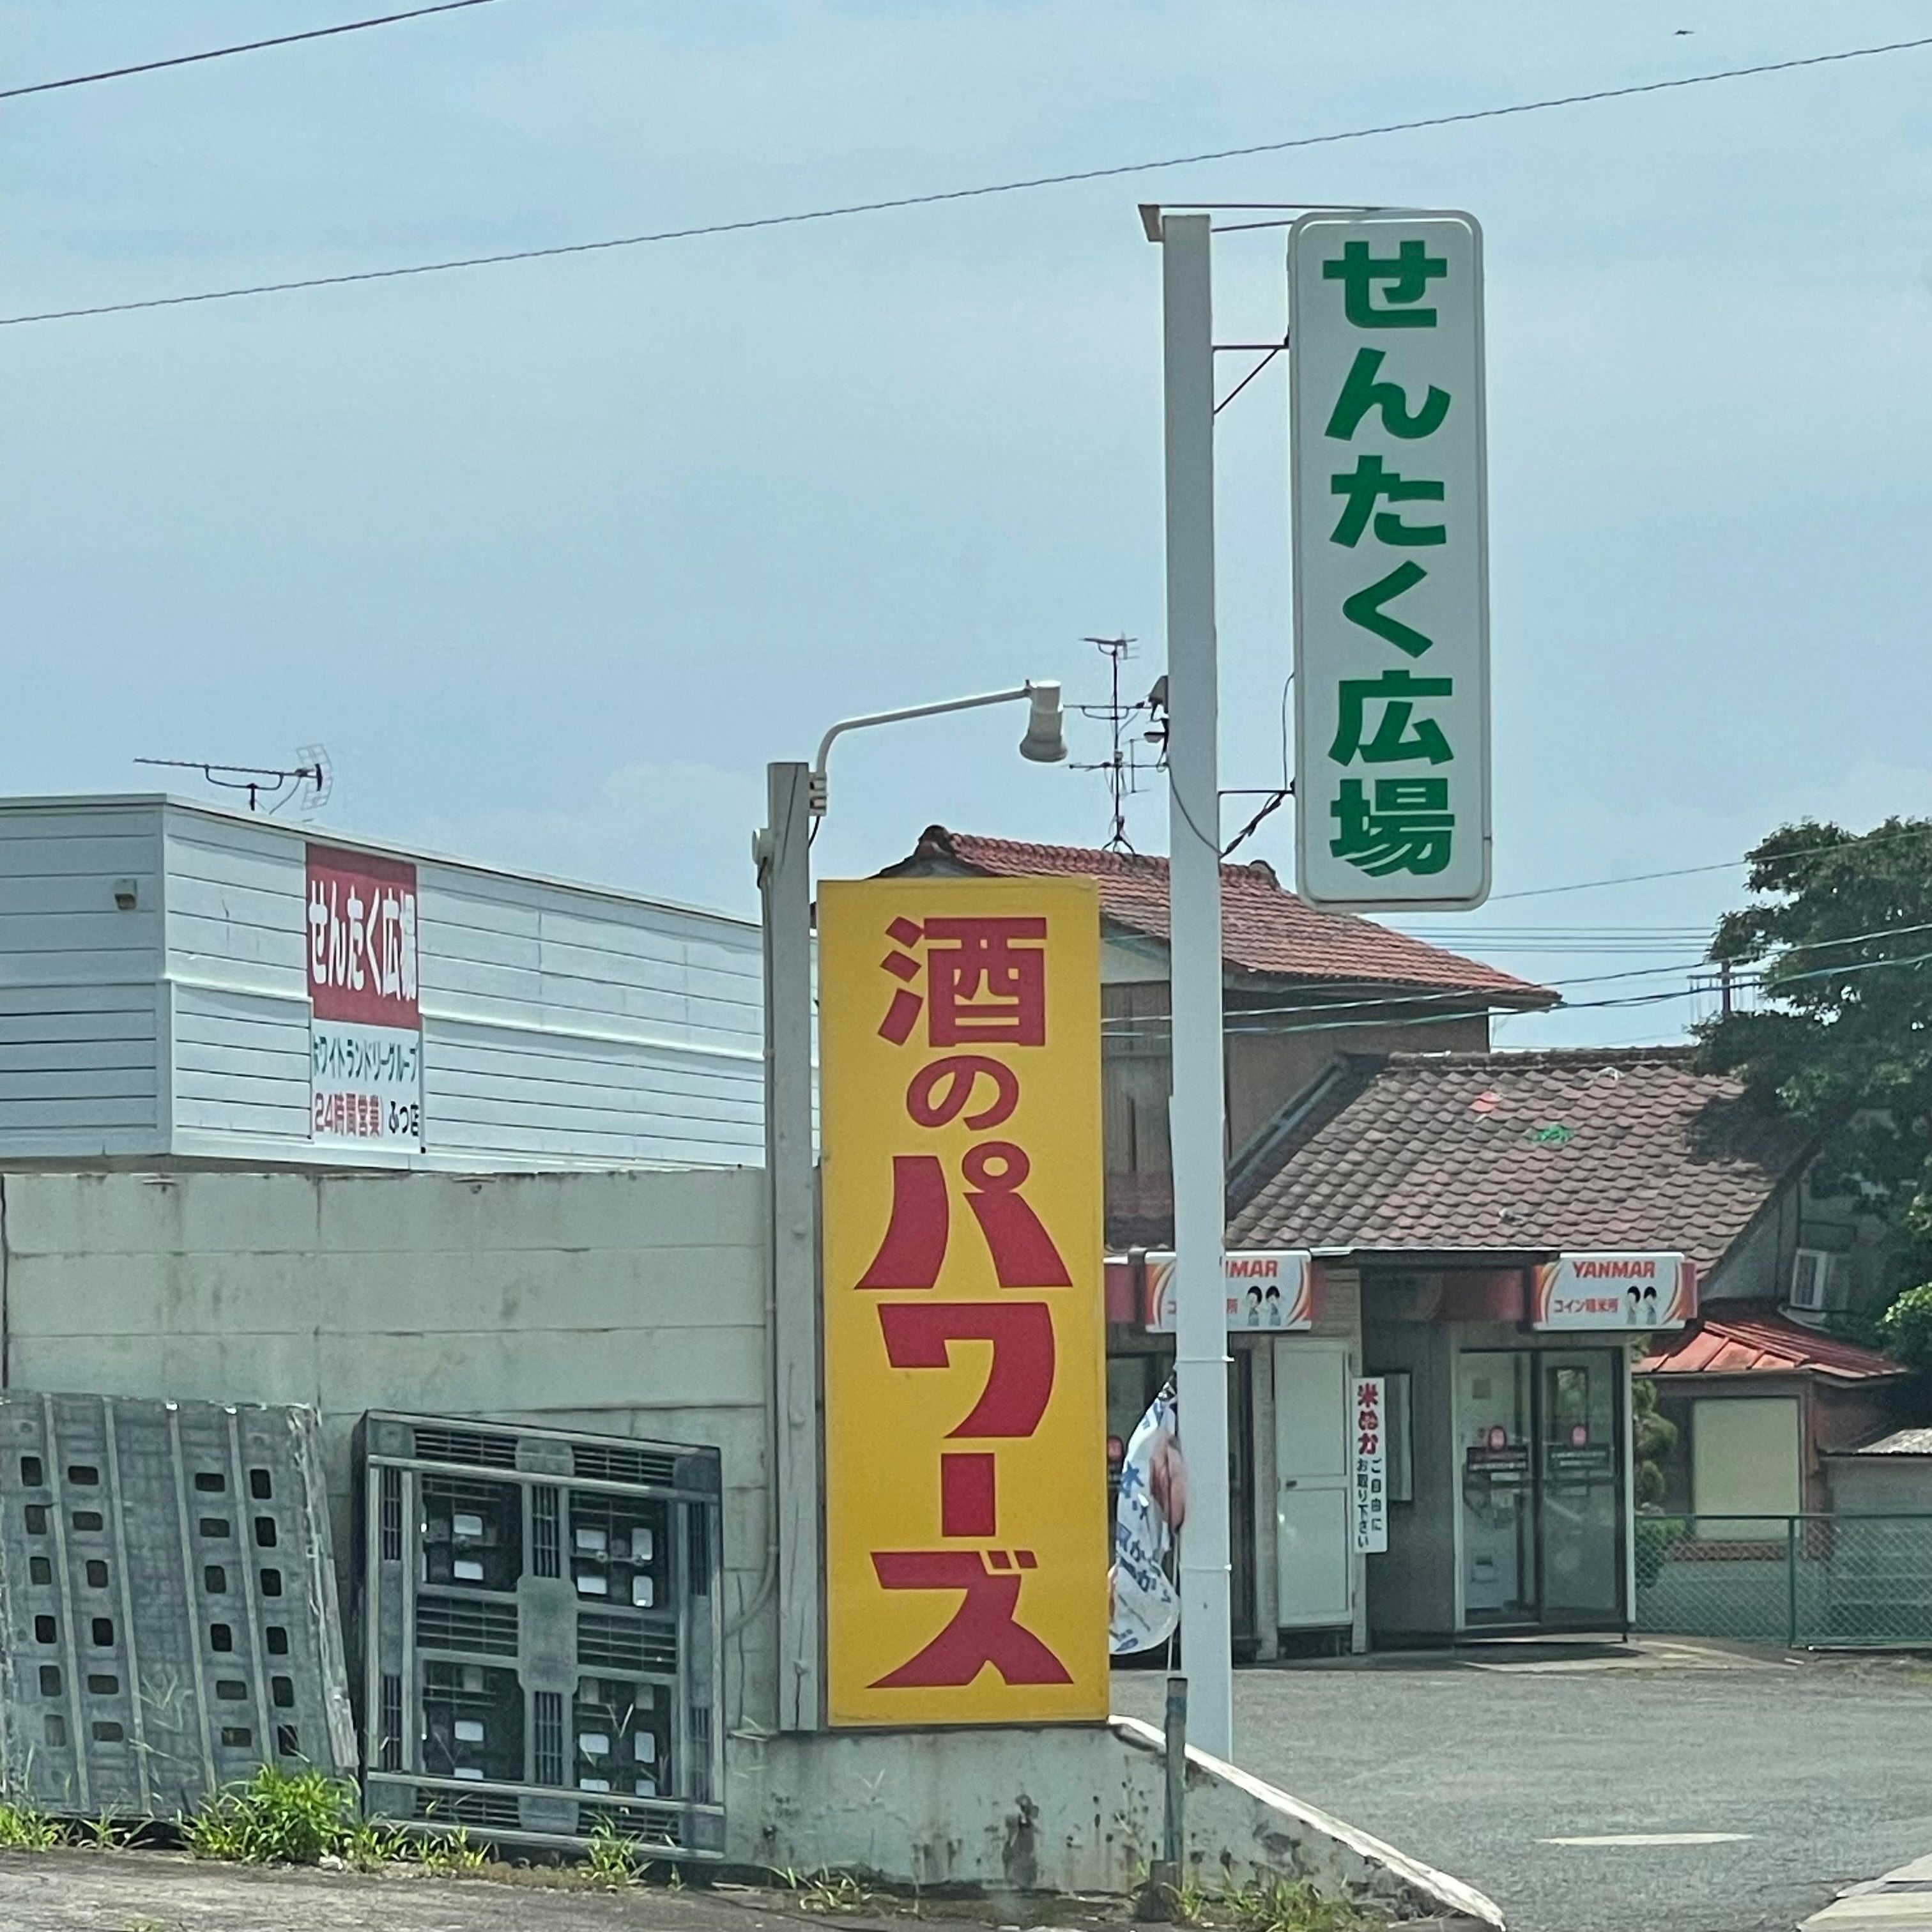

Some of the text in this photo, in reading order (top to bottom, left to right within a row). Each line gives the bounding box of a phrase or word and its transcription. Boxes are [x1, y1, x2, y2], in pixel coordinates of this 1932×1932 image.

[1322, 240, 1455, 877] せんたく広場
[309, 880, 417, 1001] せんたく広場
[854, 916, 1074, 1689] 酒のパワーズ
[1225, 1260, 1278, 1278] MAR
[1573, 1261, 1655, 1278] YANMAR
[1357, 1383, 1379, 1455] 米ぬか
